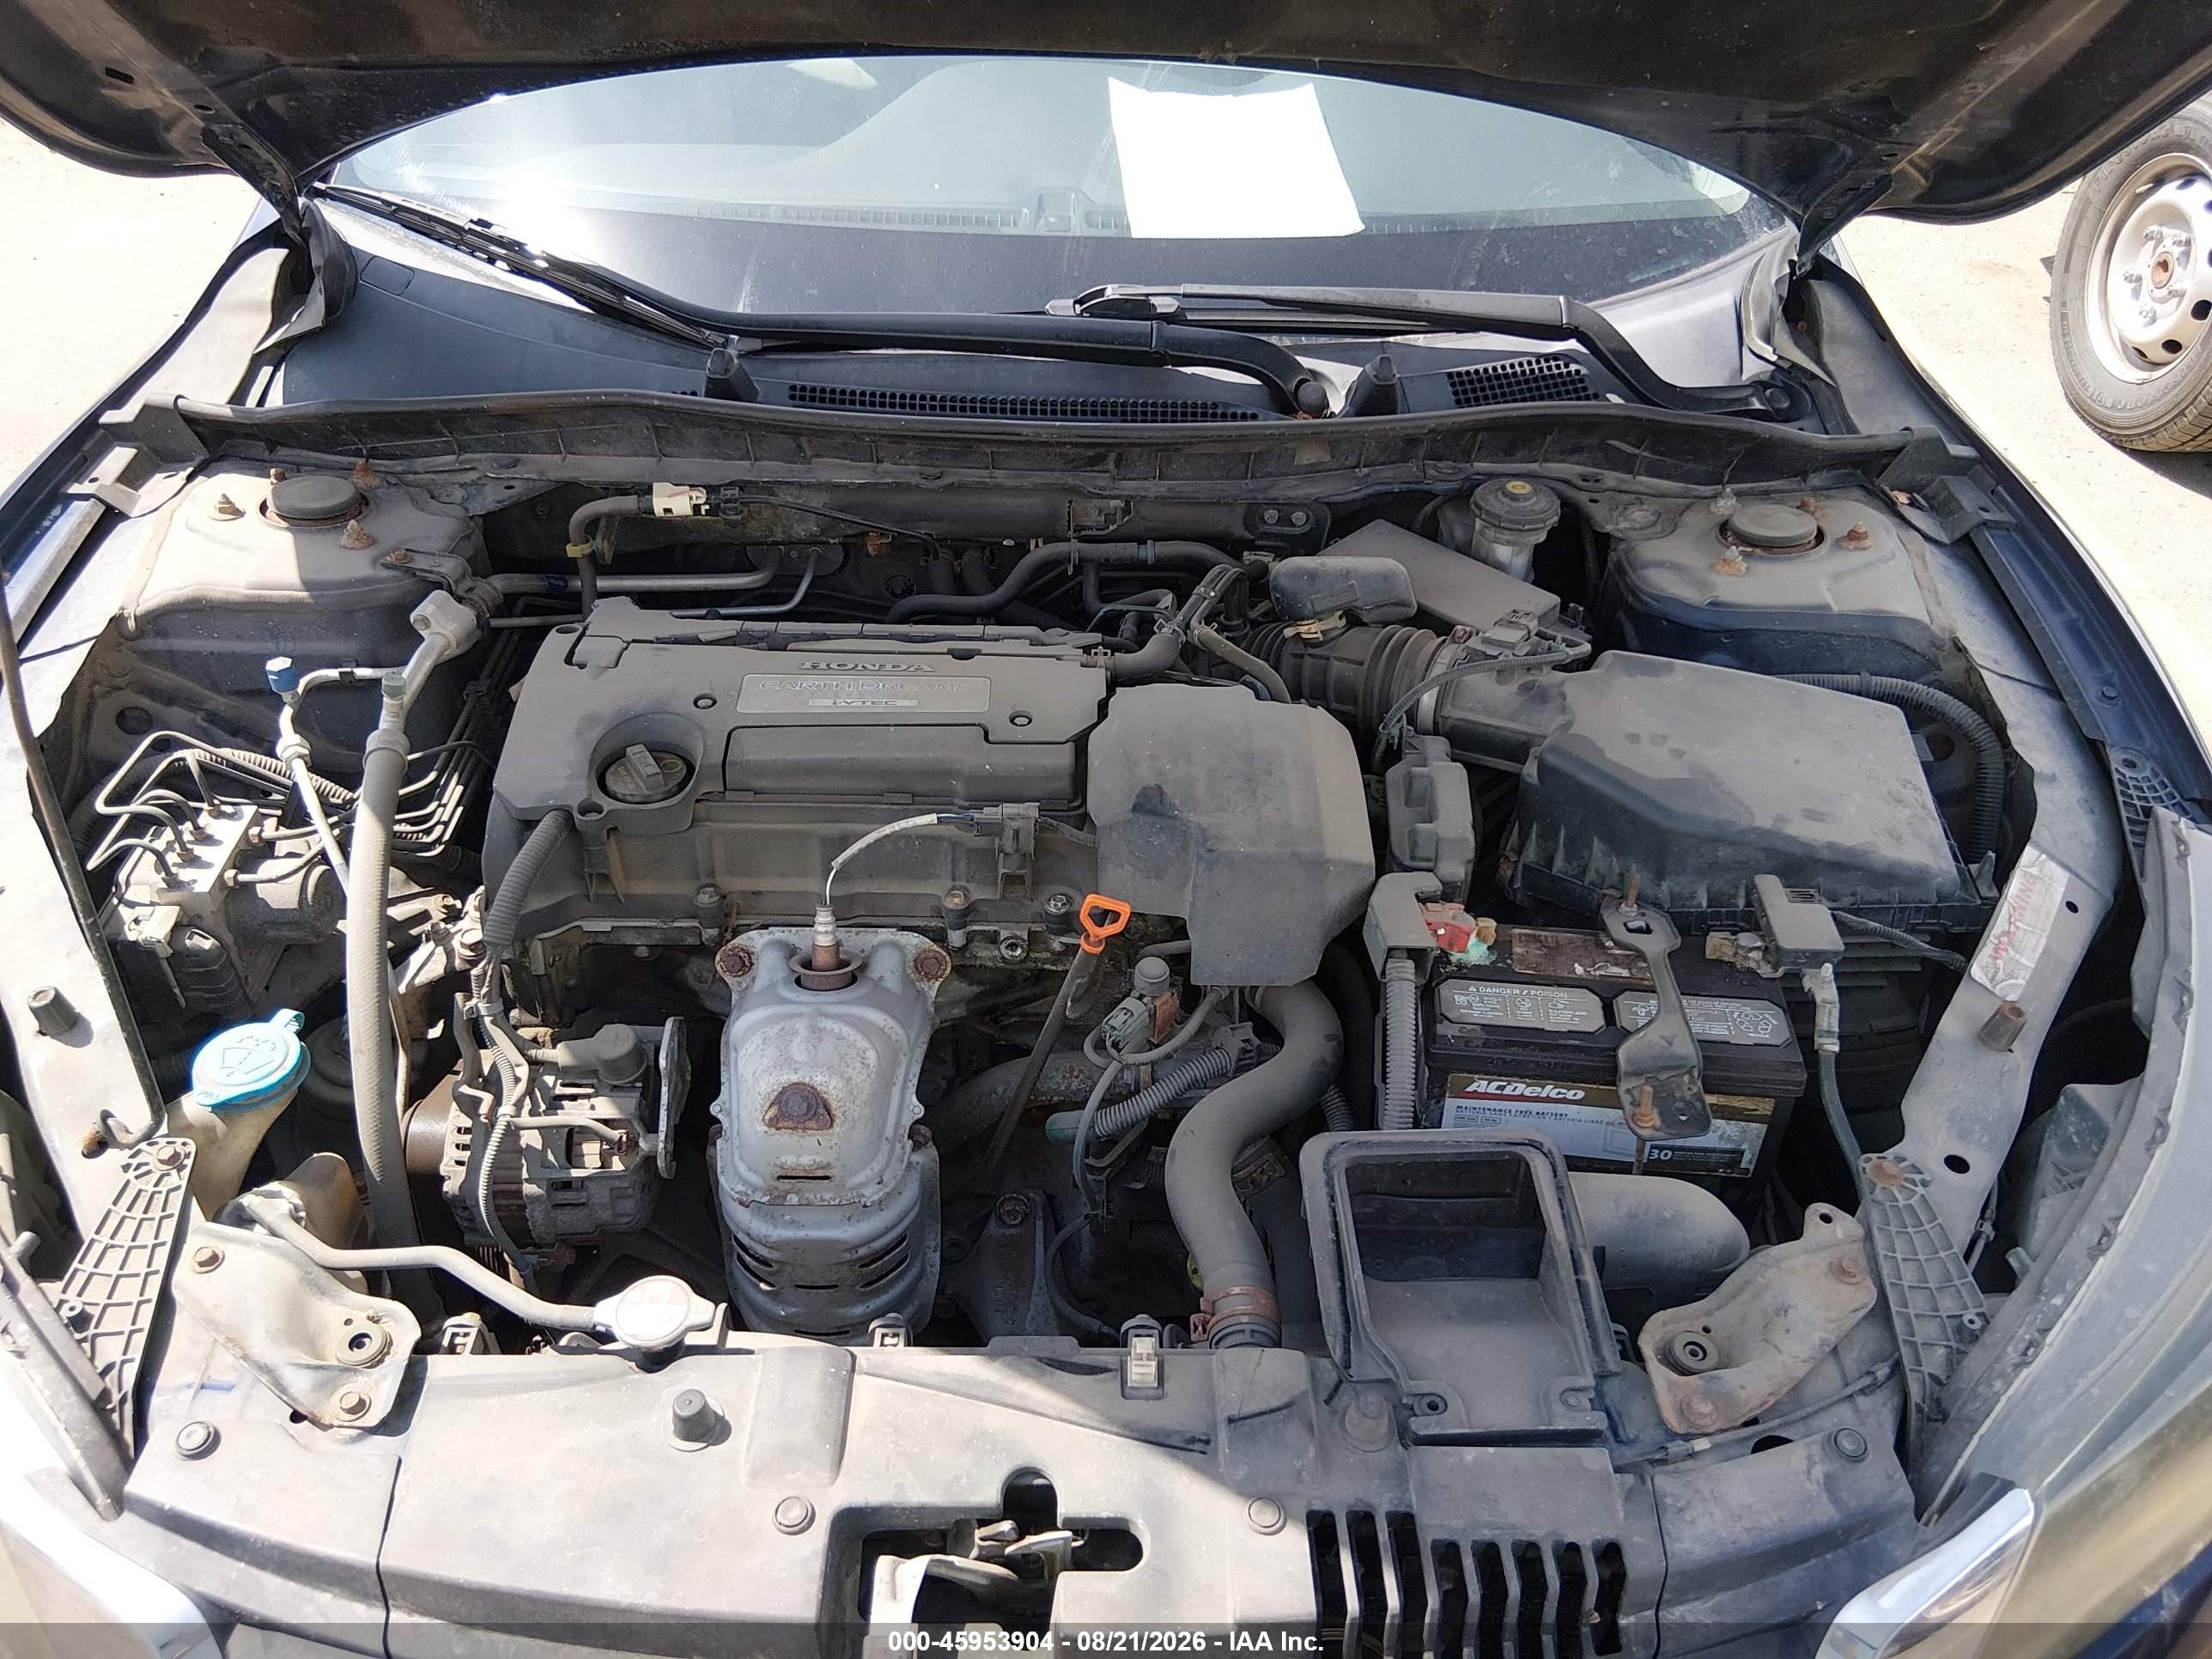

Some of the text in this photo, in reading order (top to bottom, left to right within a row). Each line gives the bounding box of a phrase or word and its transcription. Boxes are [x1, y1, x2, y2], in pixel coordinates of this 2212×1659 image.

[799, 660, 935, 672] HONDA
[760, 679, 854, 691] EARTH
[1478, 986, 1521, 996] DANGER
[1529, 989, 1569, 1000] POISON
[1464, 1079, 1586, 1100] ACDelco
[1455, 1104, 1512, 1115] MAINTENANCE
[1534, 1110, 1570, 1119] BATTERY
[1648, 1149, 1673, 1160] 30
